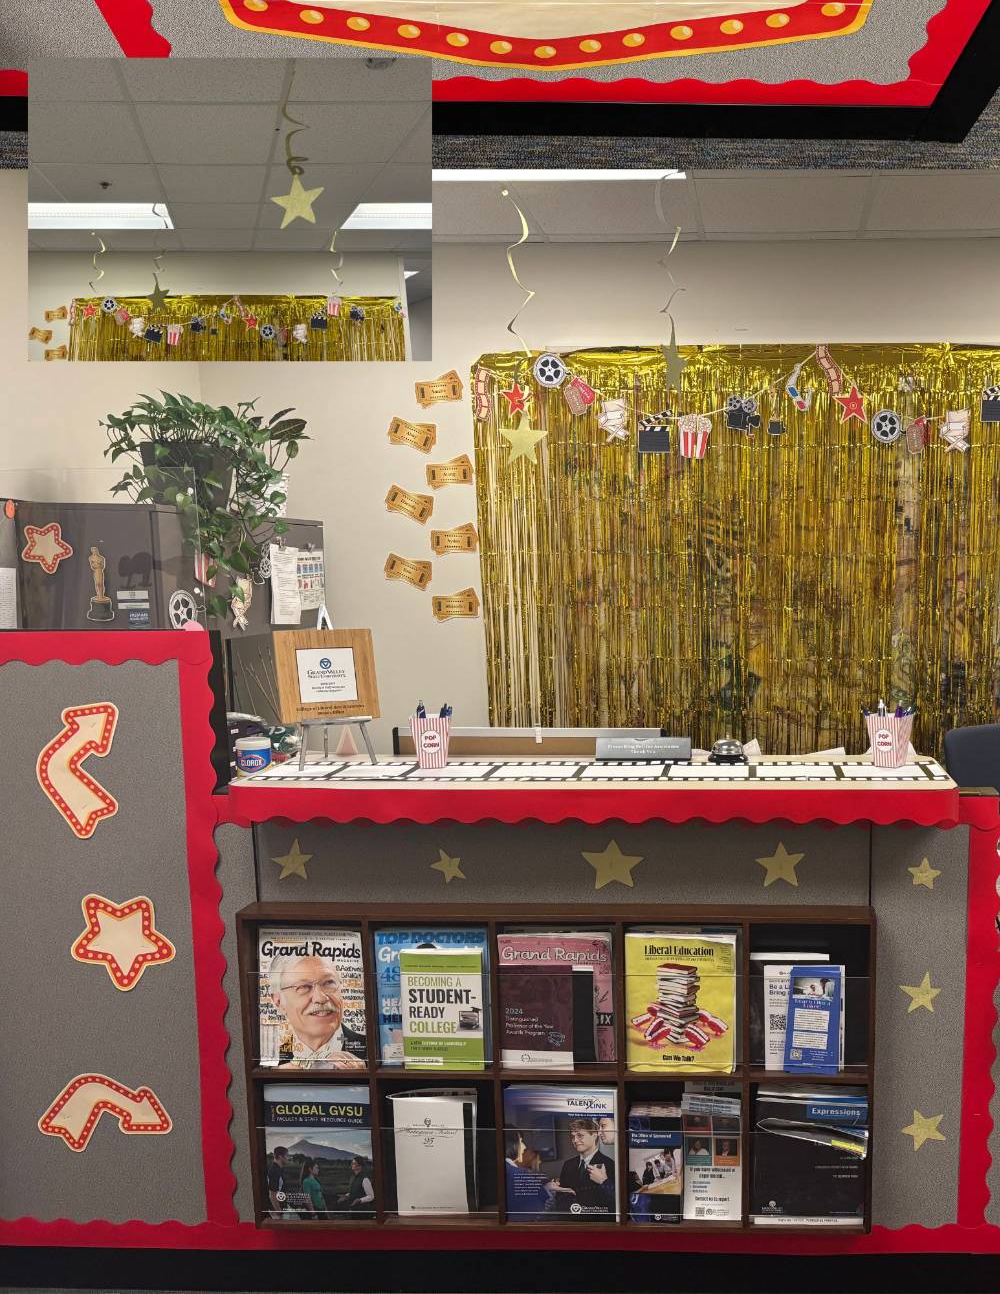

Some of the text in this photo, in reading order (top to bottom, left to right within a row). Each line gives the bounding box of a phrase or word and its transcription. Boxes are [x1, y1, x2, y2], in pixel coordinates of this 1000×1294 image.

[241, 759, 262, 767] CLOROX
[377, 931, 486, 944] TOP DOCTORS
[261, 940, 360, 962] Grand Rapids
[501, 946, 607, 963] Grand Rapids
[644, 945, 714, 956] Liberal Education
[407, 976, 462, 987] BECOMING A
[408, 988, 476, 1004] STUDENT-
[409, 1006, 445, 1019] READY
[409, 1020, 457, 1034] COLLEGE
[276, 1104, 363, 1117] GLOBAL GVSU
[812, 1107, 861, 1116] Expressions
